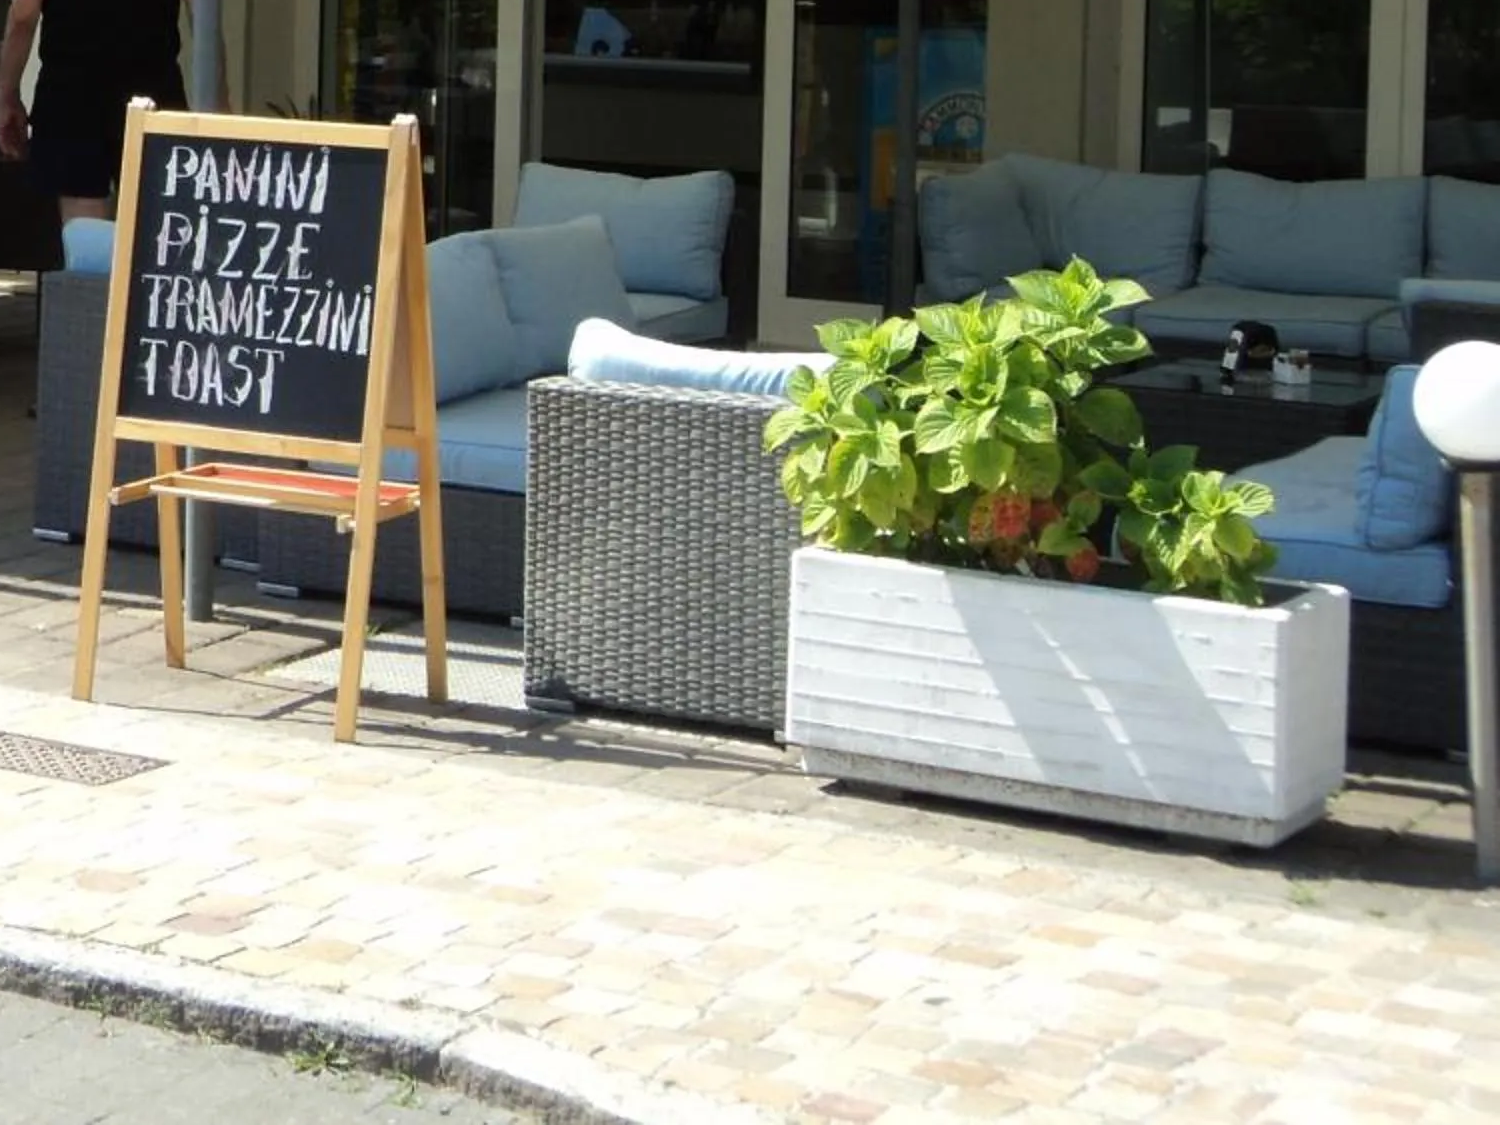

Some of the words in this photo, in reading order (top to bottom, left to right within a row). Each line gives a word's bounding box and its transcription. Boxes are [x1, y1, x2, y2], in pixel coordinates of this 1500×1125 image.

[161, 144, 330, 214] PANINI
[156, 205, 321, 281] PIZZE
[141, 274, 373, 357] TRAMEZZINI
[140, 338, 284, 414] TOAST
